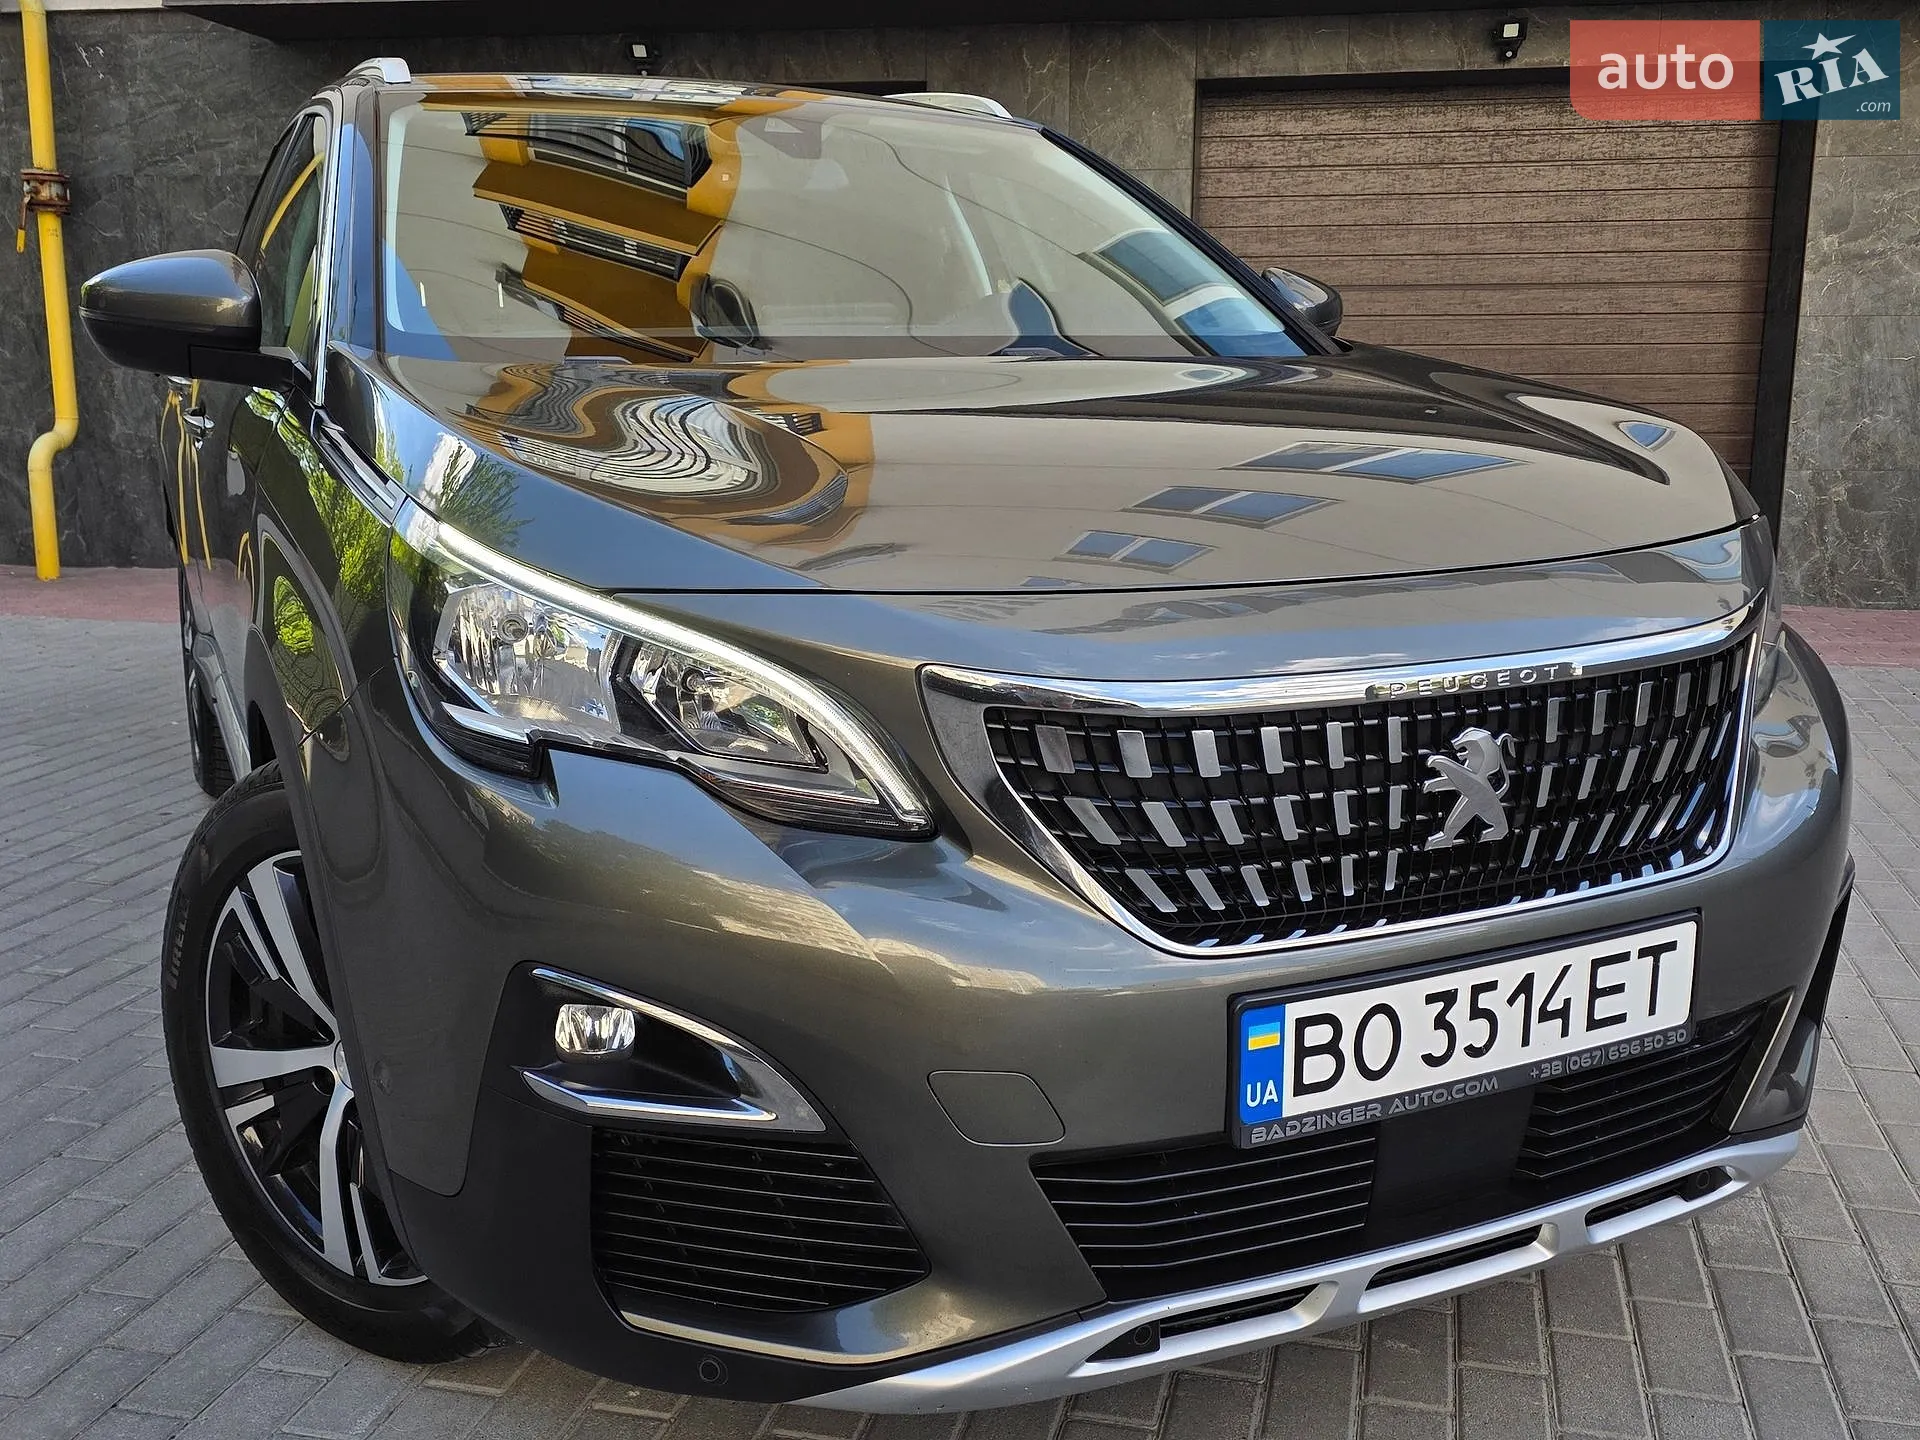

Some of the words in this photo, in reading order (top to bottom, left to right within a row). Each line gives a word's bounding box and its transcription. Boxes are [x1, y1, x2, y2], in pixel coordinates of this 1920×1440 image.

[1389, 664, 1559, 699] PEUGEOT
[167, 895, 191, 990] PIREL
[1530, 1061, 1563, 1079] +38
[1566, 1049, 1605, 1074] (067)
[1608, 1040, 1641, 1061] 696
[1643, 1035, 1665, 1052] 50
[1666, 1028, 1688, 1046] 30
[1246, 1079, 1279, 1108] UA
[1250, 1102, 1382, 1144] BADZINGER
[1388, 1075, 1499, 1115] AUTO.COM
